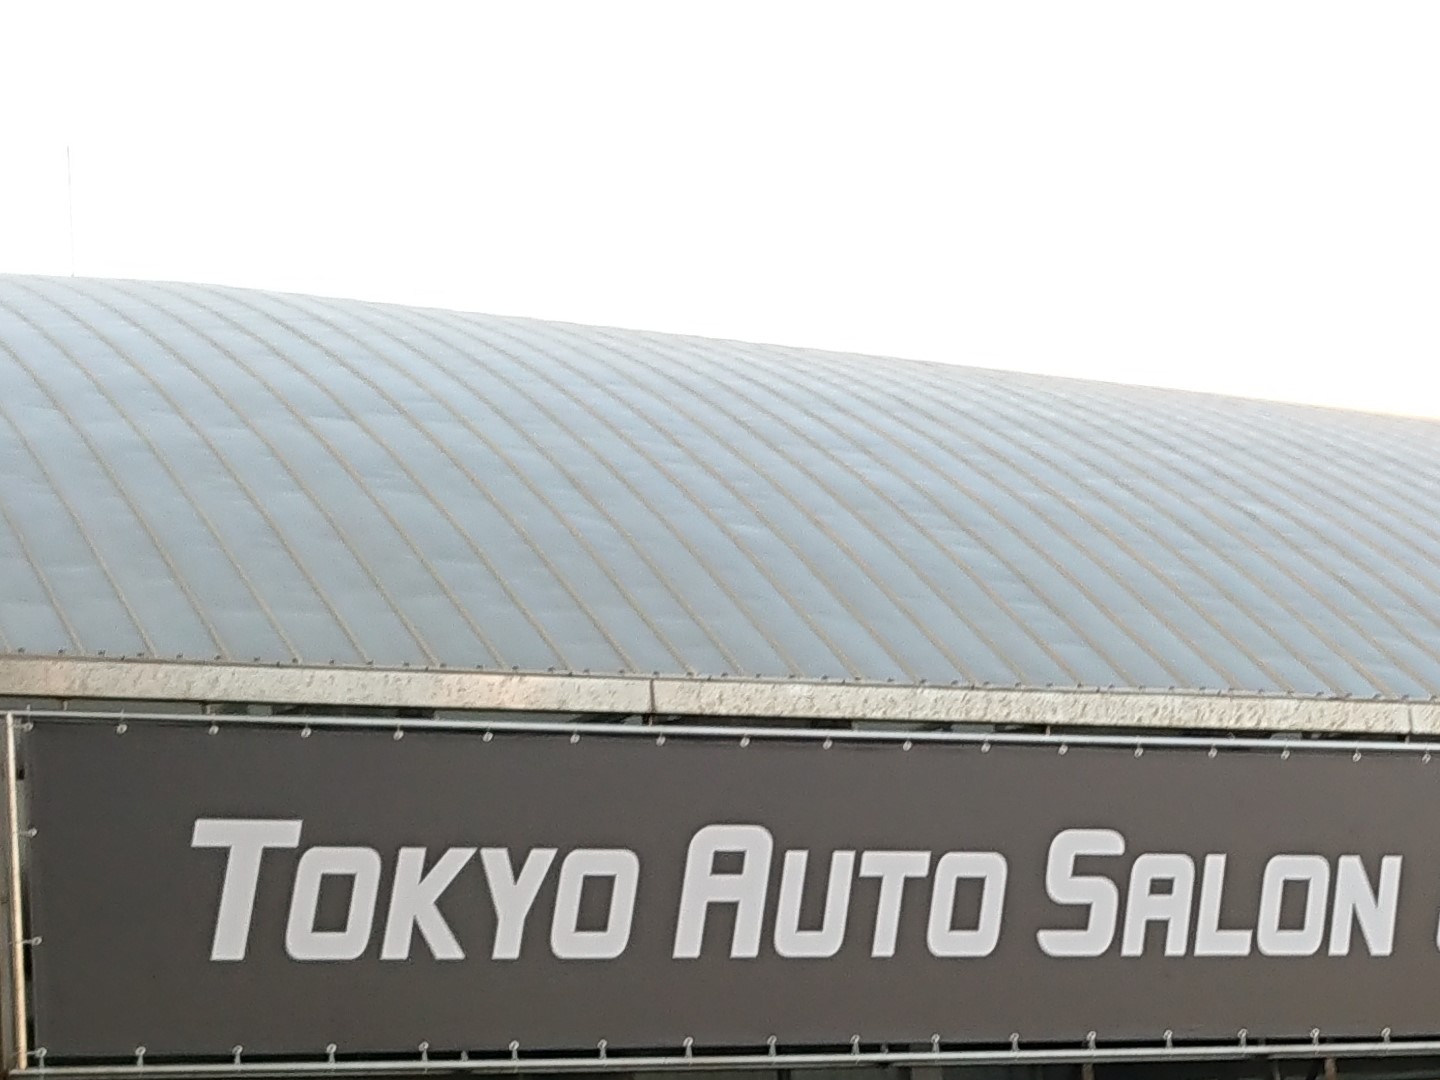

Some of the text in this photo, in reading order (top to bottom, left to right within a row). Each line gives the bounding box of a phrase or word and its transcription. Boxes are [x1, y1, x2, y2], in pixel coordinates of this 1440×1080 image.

[191, 819, 641, 961] TOKYO
[672, 824, 1008, 958] AUTO
[1036, 828, 1403, 957] SALON
